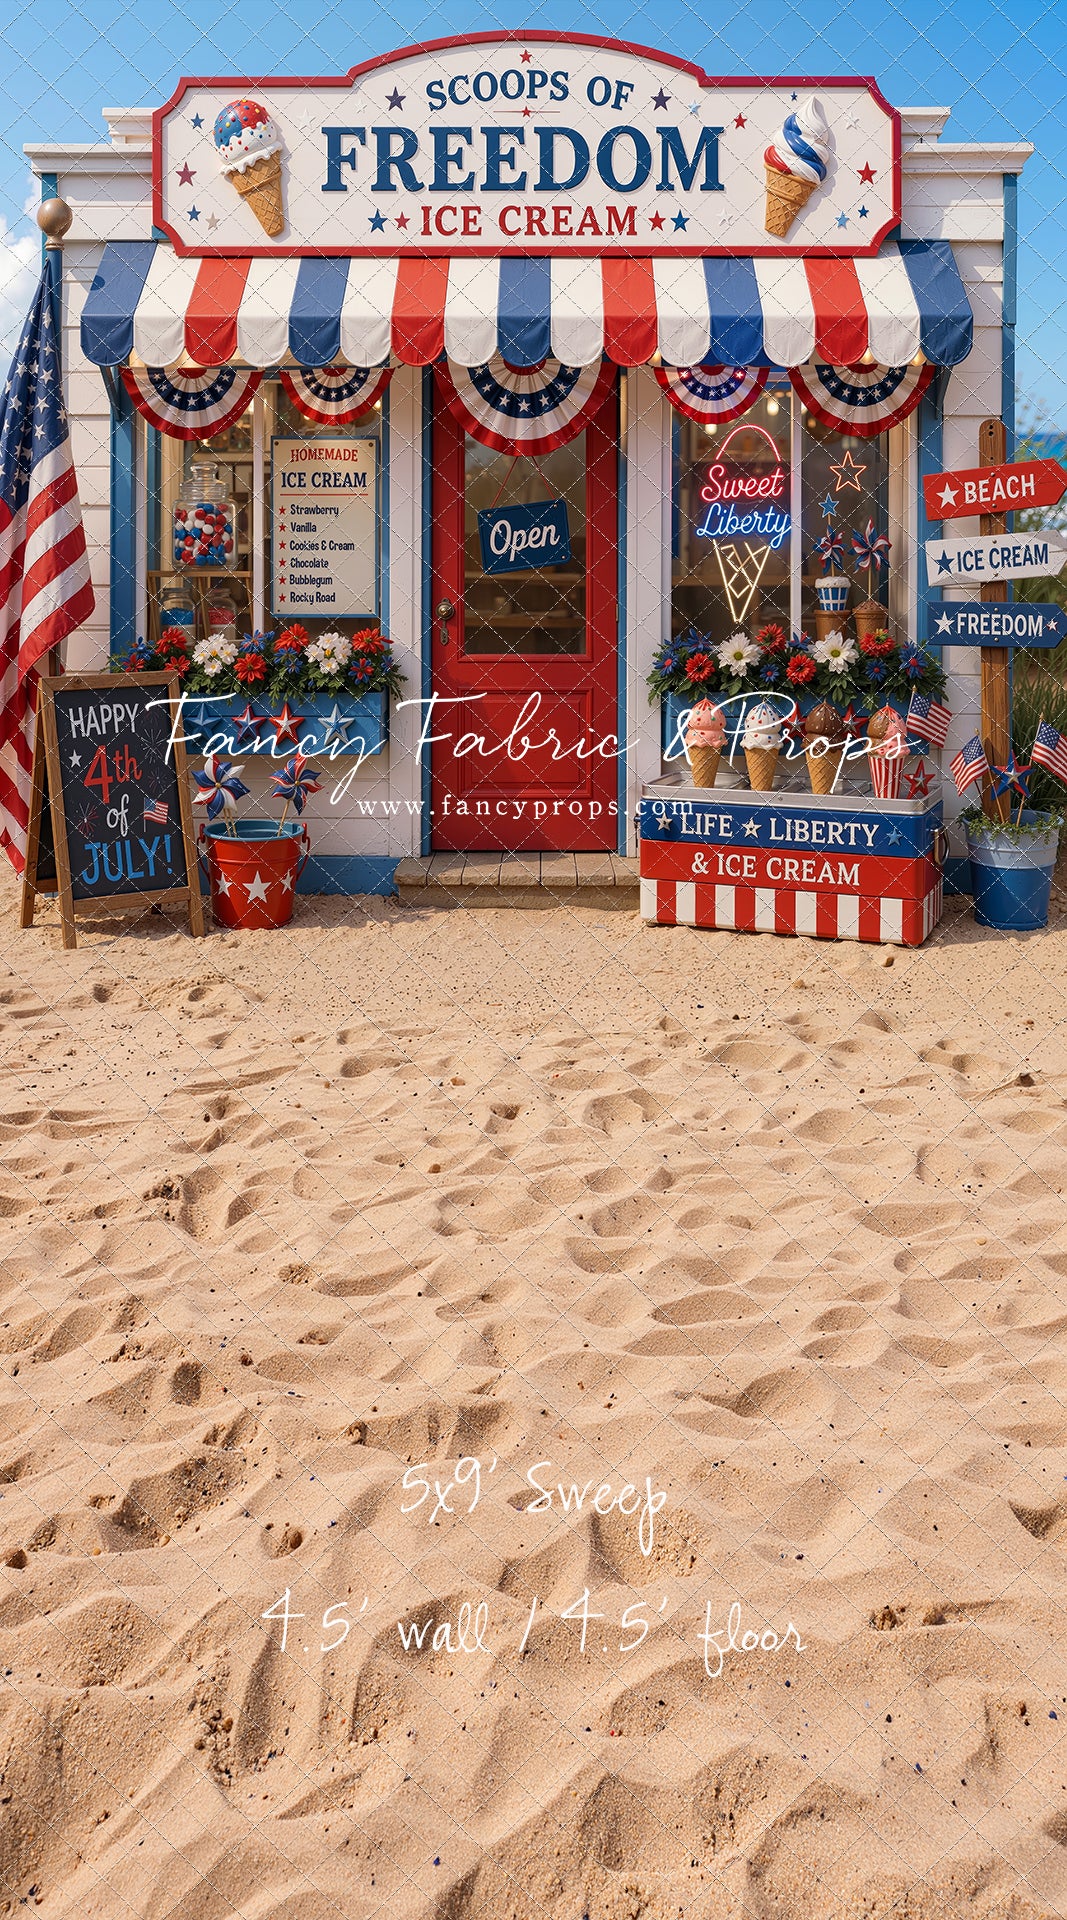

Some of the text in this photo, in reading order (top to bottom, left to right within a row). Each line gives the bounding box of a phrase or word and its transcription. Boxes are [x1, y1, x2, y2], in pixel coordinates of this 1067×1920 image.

[426, 69, 635, 112] SCOOPS OF
[320, 125, 728, 193] FREEDOM
[420, 206, 638, 236] ICE CREAM
[290, 448, 359, 463] HOMEMADE
[281, 472, 367, 488] ICE CREAM
[701, 464, 785, 502] Sweet
[964, 473, 1035, 504] BEACH
[290, 504, 339, 517] Strawberry
[696, 502, 792, 549] Liberty
[290, 522, 317, 534] Vanilla
[489, 519, 561, 562] Open
[289, 540, 355, 551] Cookies & Cream
[956, 543, 1049, 572] ICE CREAM
[290, 558, 329, 569] Chocolate
[289, 575, 333, 587] Bubblegum
[290, 592, 336, 605] Rocky Road
[957, 612, 1043, 637] FREEDOM
[68, 703, 139, 739] HAPPY
[83, 744, 143, 804] 4th
[106, 793, 130, 837] of
[680, 812, 880, 848] LIFE LIBERTY
[81, 834, 173, 885] JULY!
[691, 852, 860, 886] & ICE CREAM
